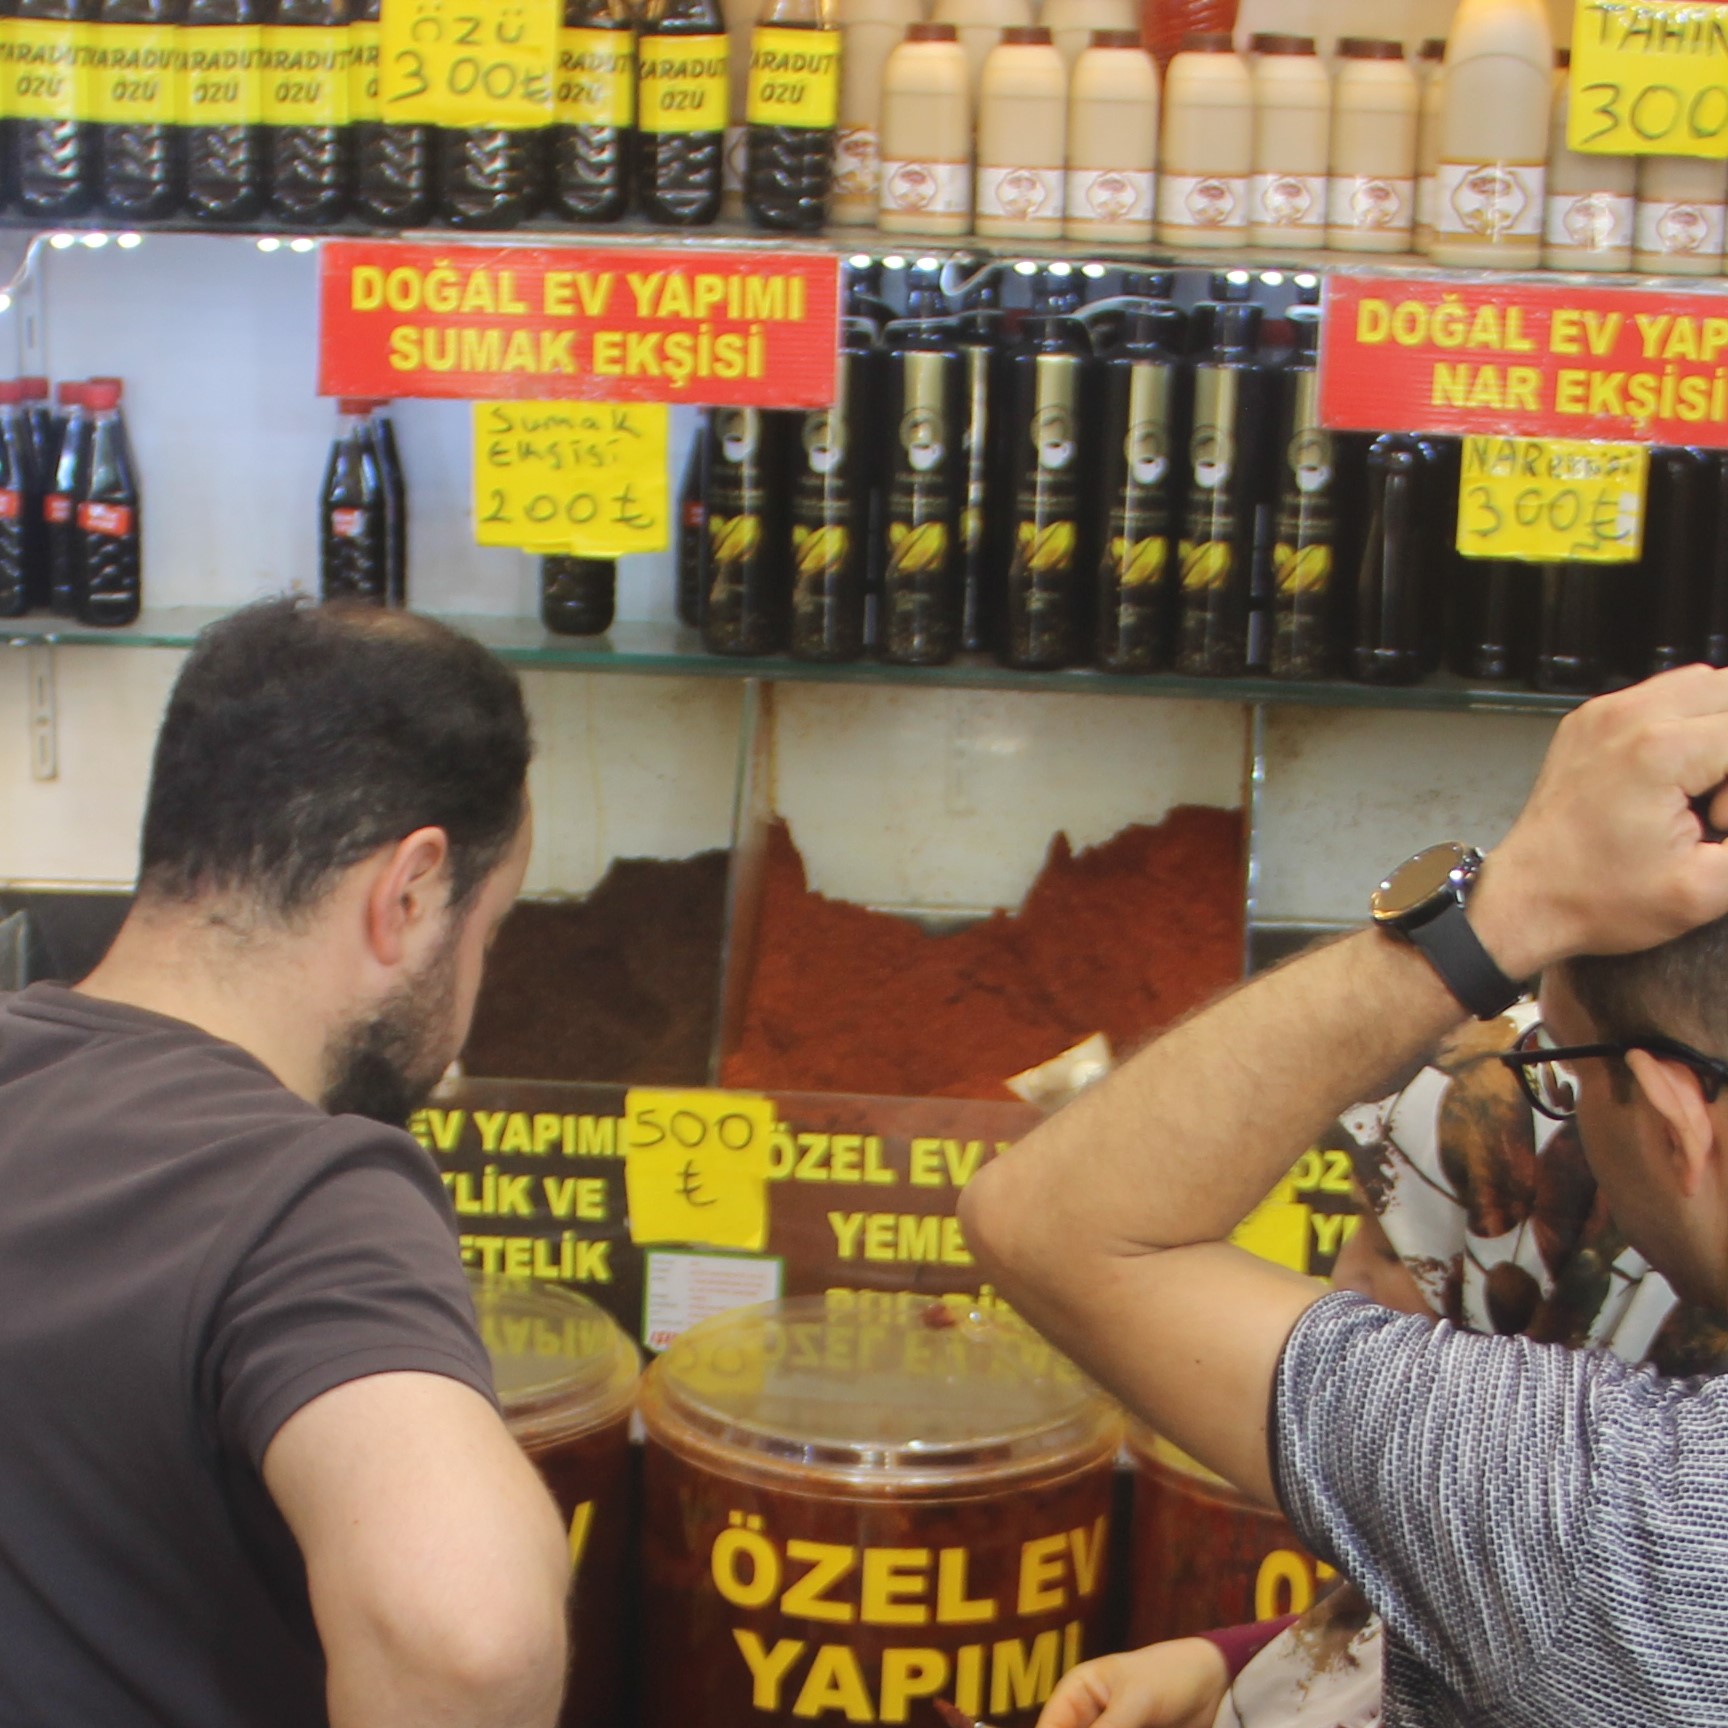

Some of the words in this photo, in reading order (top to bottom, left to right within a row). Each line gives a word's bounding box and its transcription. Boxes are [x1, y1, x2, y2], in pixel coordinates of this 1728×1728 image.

[350, 258, 527, 317] DOĞAL
[544, 270, 610, 316] EV
[631, 271, 805, 322] YAPIMI
[1356, 292, 1533, 353] DOĞAL
[1549, 308, 1619, 356] EV
[390, 326, 576, 374] SUMAK
[592, 324, 765, 390] EKŞİSİ
[1432, 363, 1541, 413] NAR
[474, 1111, 627, 1157] YAPIMI
[629, 1109, 753, 1151] 500
[543, 1176, 607, 1221] VE
[711, 1510, 996, 1625] ÖZEL
[1017, 1514, 1108, 1616] EV
[731, 1620, 1083, 1725] YAPIMI
